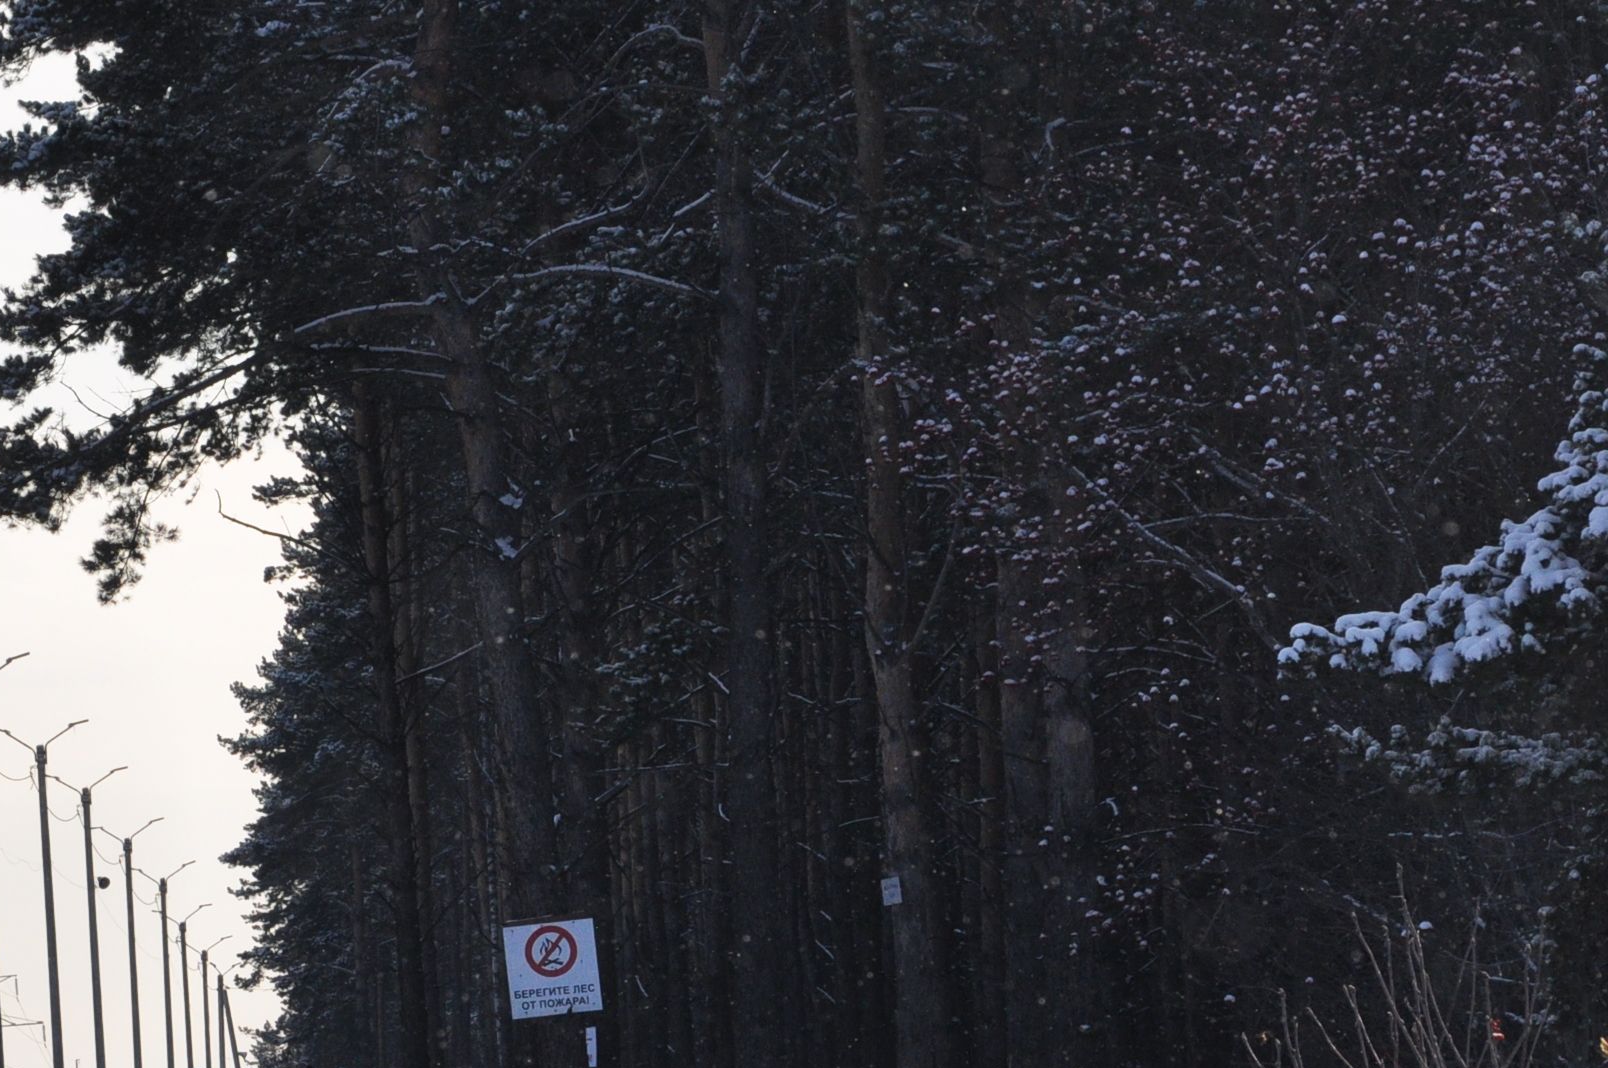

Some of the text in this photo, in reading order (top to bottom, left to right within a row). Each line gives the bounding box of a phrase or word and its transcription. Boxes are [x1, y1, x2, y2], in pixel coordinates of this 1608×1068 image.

[514, 983, 595, 999] БЕРЕГИТЕ ЛЕС
[521, 996, 590, 1010] ОТ ПОЖАРА!
